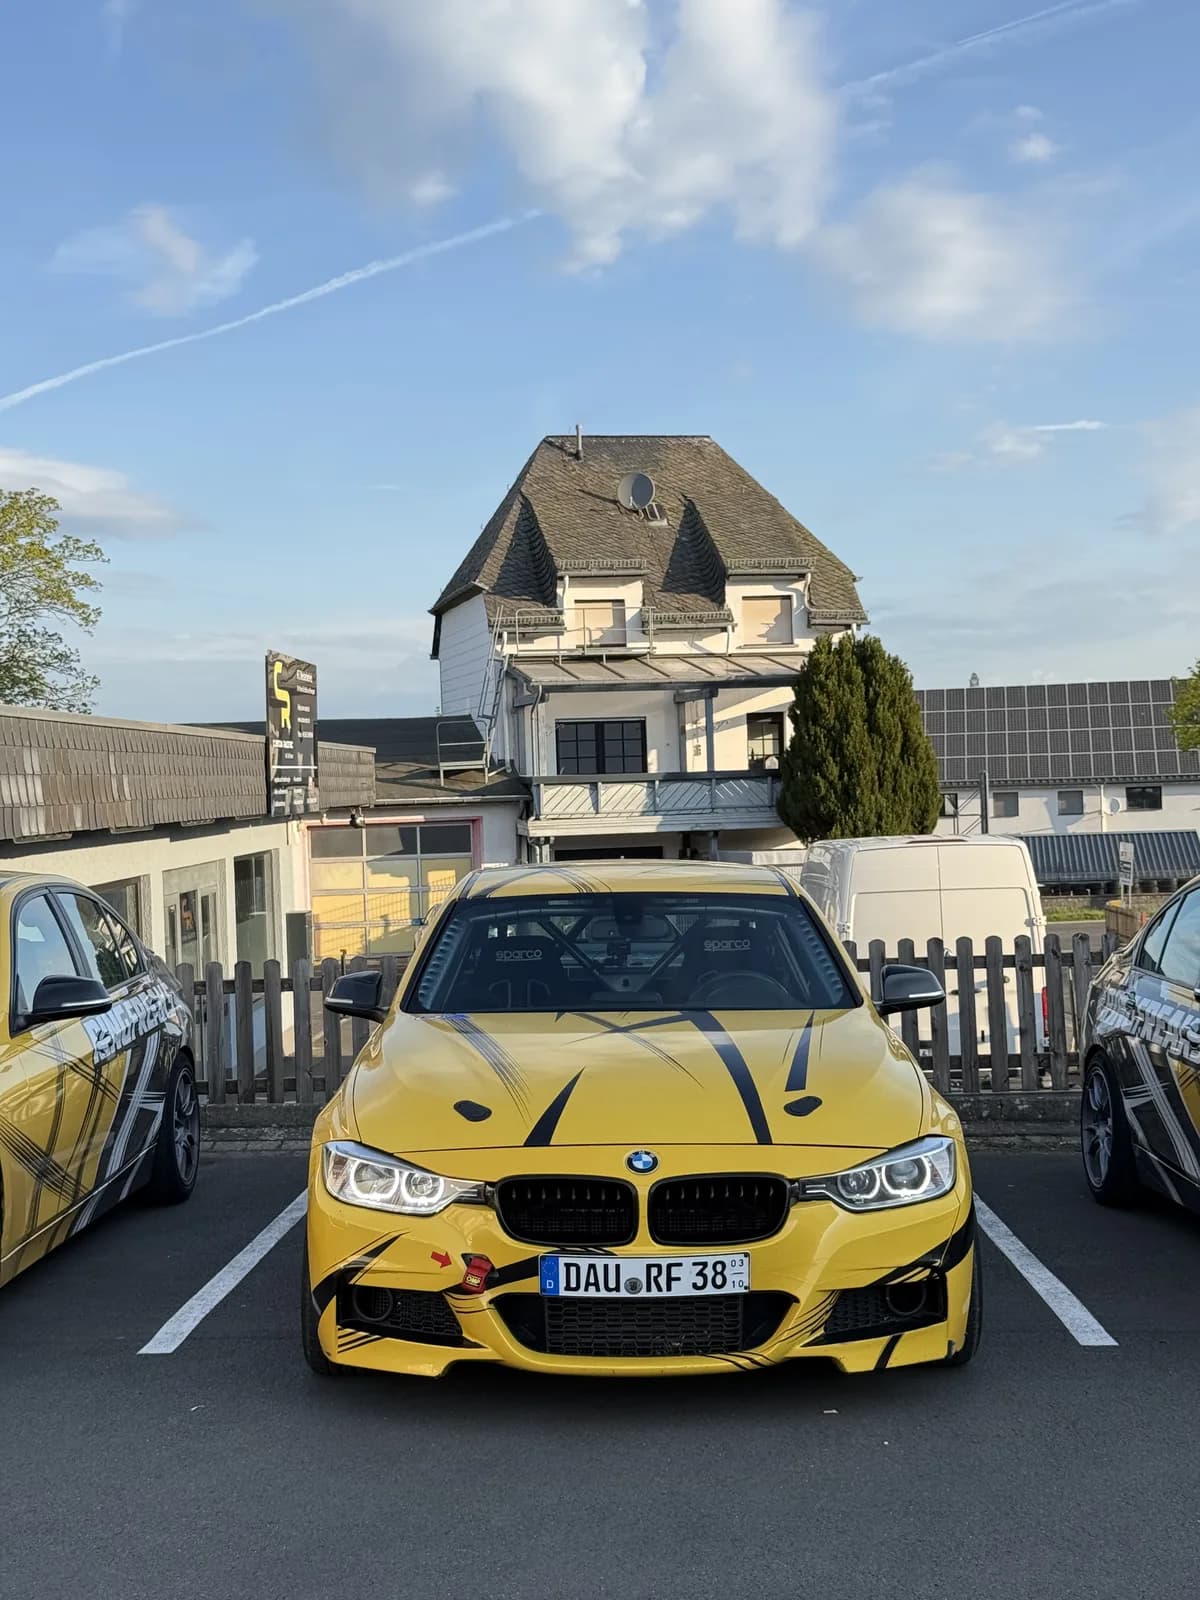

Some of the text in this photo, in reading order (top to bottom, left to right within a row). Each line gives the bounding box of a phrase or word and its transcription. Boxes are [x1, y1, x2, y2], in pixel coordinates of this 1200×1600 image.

[704, 939, 751, 952] sparco
[495, 949, 543, 961] sparco
[730, 1258, 744, 1268] 03
[563, 1259, 727, 1293] DAU RF 38
[546, 1279, 554, 1289] D
[731, 1279, 744, 1289] 10
